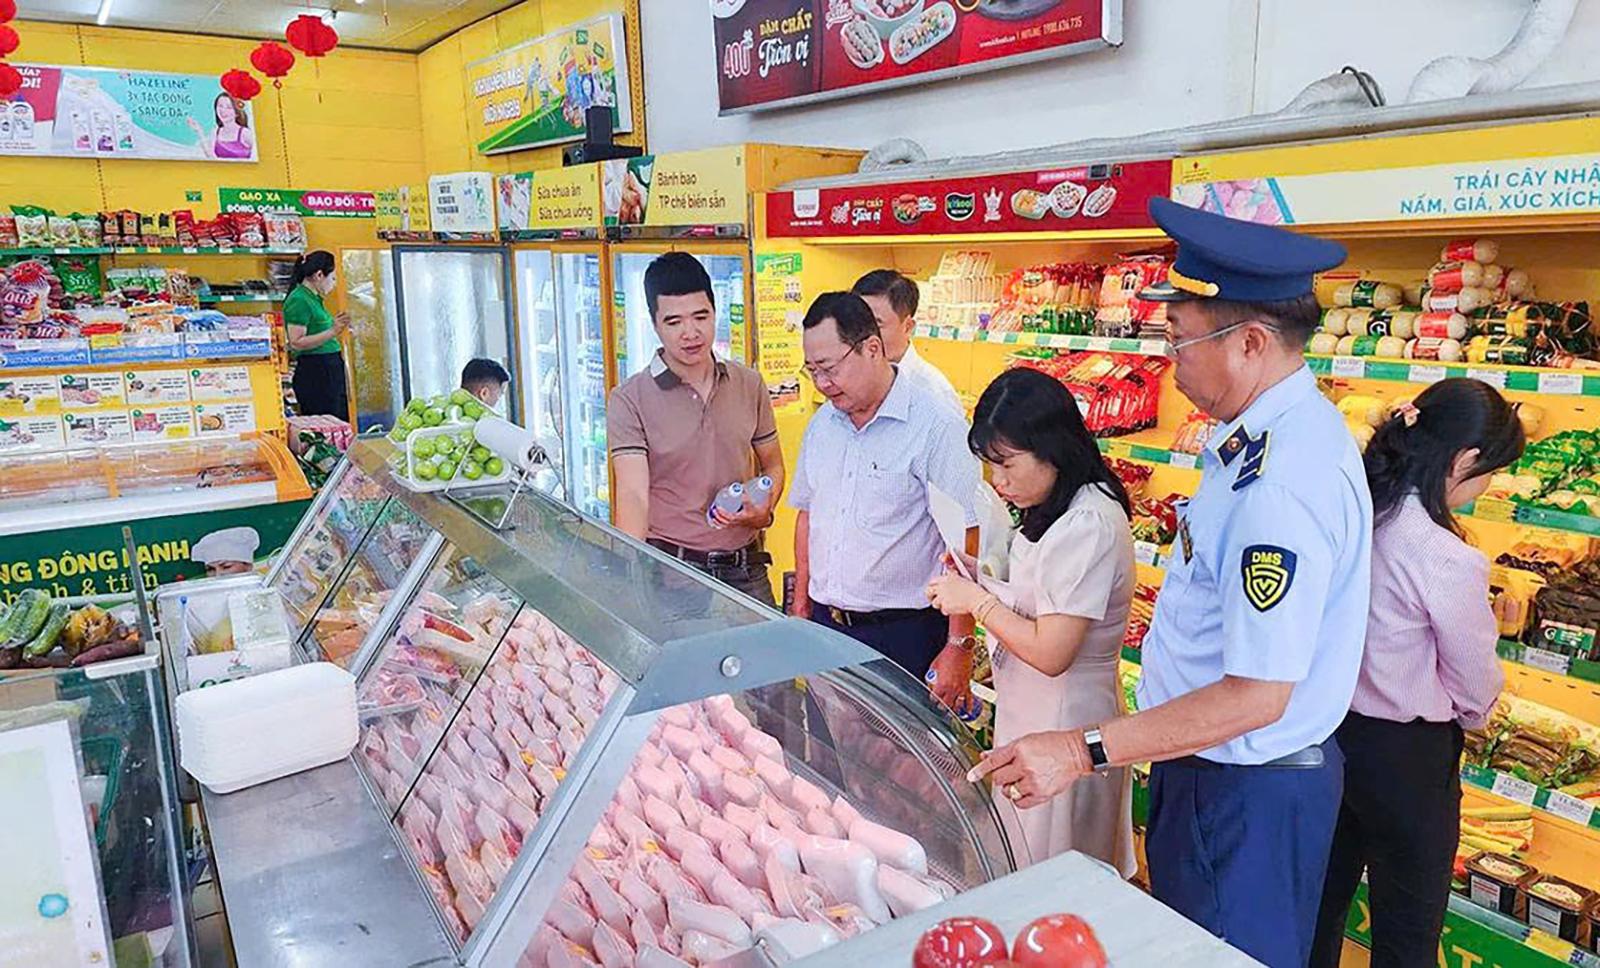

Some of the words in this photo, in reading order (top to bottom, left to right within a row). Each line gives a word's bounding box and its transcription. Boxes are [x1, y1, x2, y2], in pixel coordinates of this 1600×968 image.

[780, 8, 813, 35] CHẤT
[128, 78, 188, 89] HAZELINE
[657, 171, 679, 186] Bánh
[680, 171, 697, 185] bao
[1454, 170, 1499, 190] TRÁI
[1506, 167, 1547, 188] CÂY
[552, 184, 570, 198] chua
[308, 196, 332, 207] BAO
[658, 194, 670, 209] TP
[1400, 193, 1448, 214] NẤM,
[1454, 192, 1493, 212] GIÁ,
[1500, 189, 1543, 209] XÚC
[1550, 187, 1600, 208] XÍCH
[553, 205, 572, 219] chua
[38, 550, 118, 580] ĐÔNG
[1251, 551, 1283, 566] DMS
